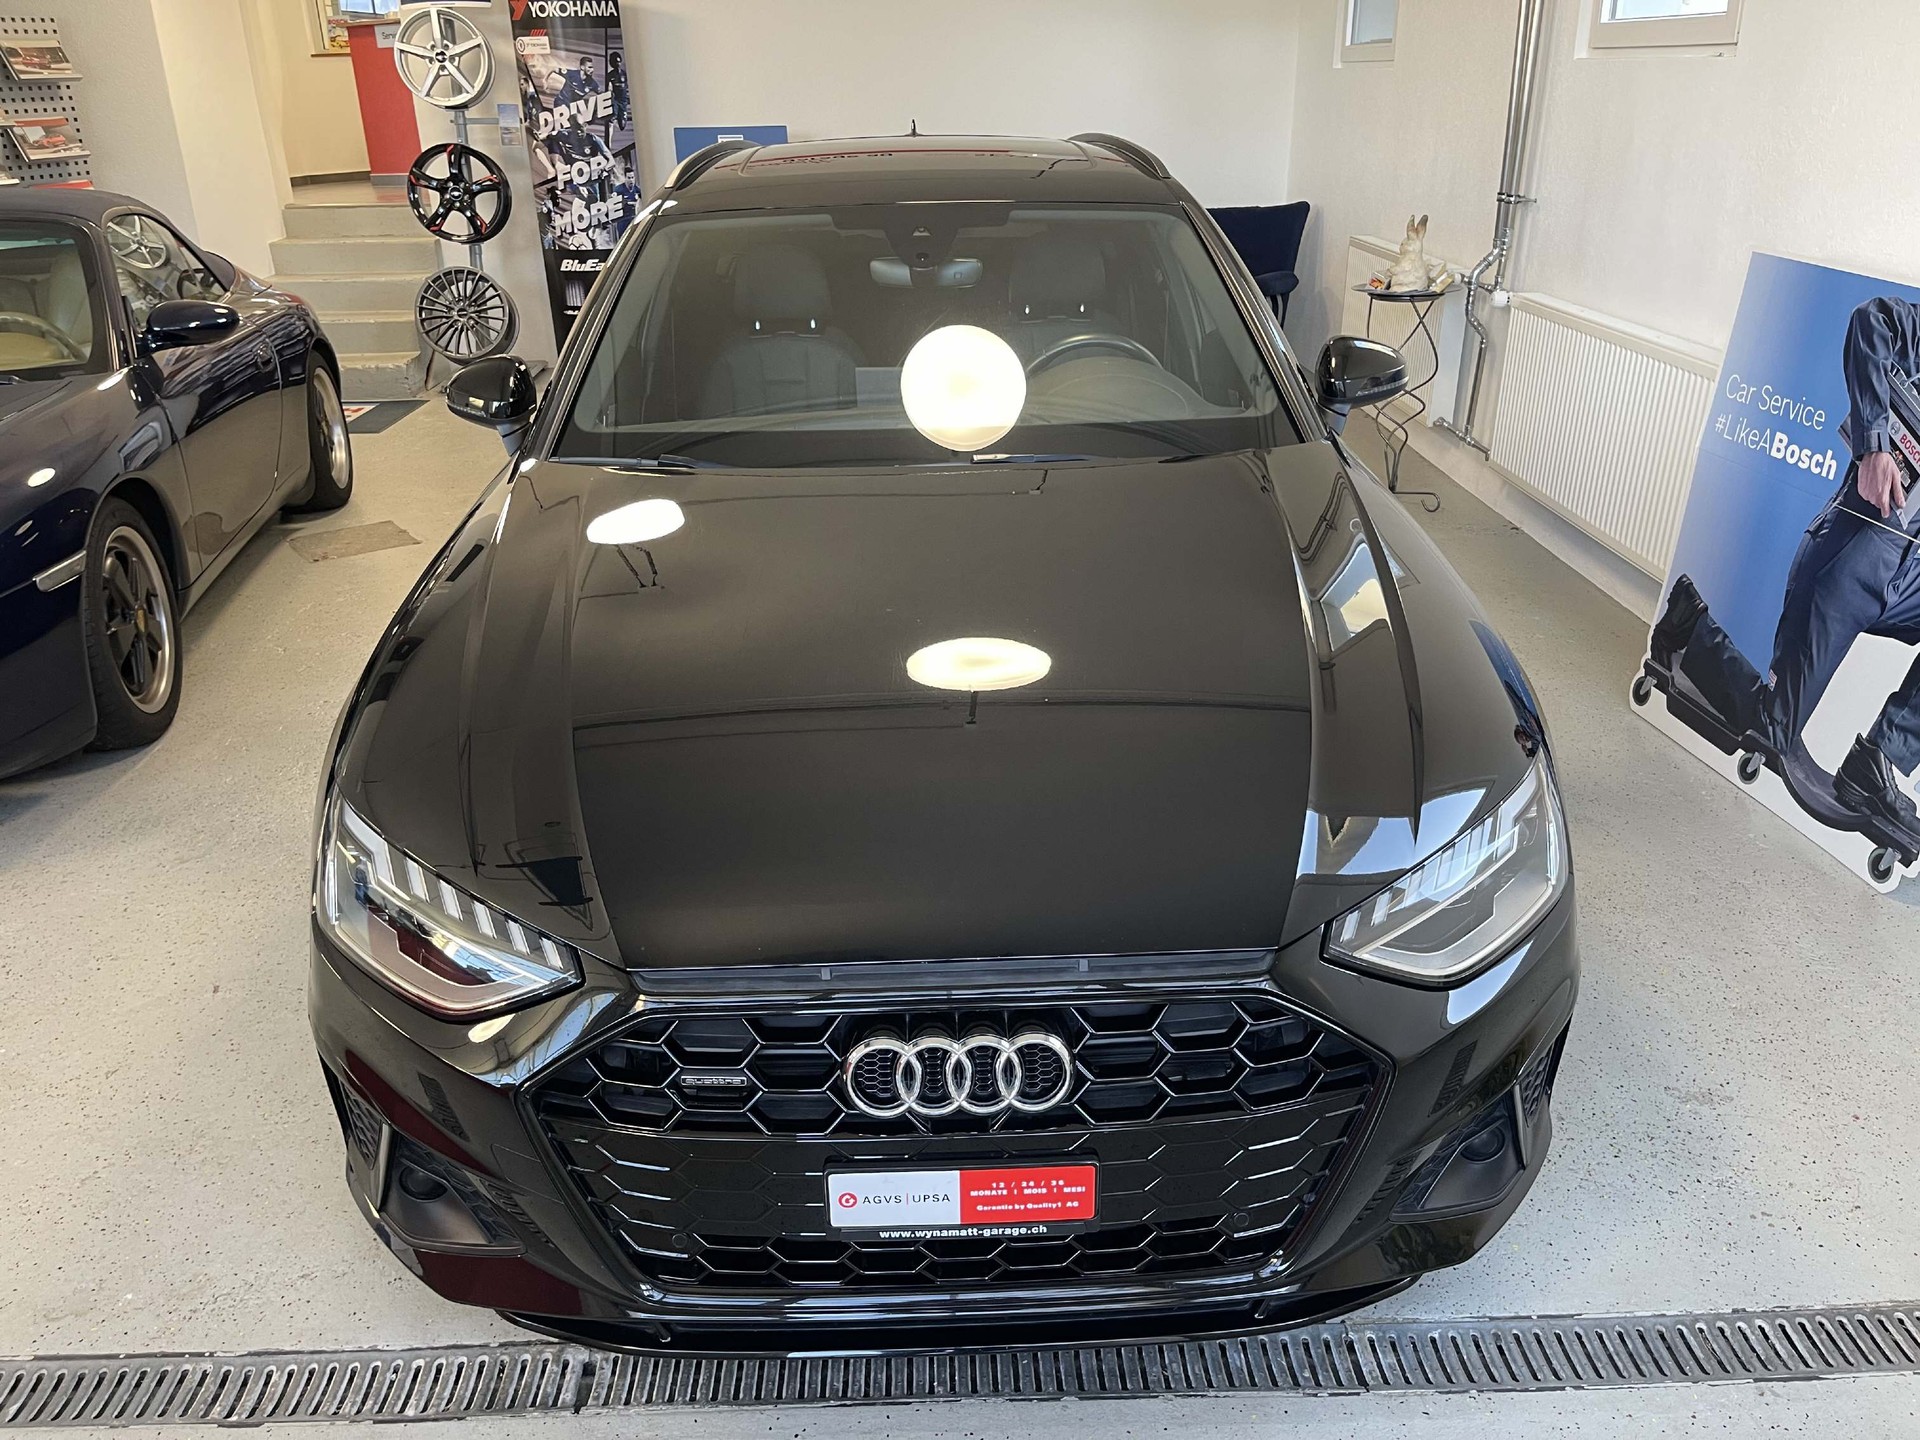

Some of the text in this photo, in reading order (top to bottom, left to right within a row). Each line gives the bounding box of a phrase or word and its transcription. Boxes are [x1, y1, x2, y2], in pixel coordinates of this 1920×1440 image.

[528, 0, 618, 18] YOKOHAMA
[553, 195, 624, 237] MORE
[1726, 374, 1826, 431] Car Service
[1714, 413, 1838, 481] #LikeABosch
[862, 1193, 951, 1205] AGVS UPSA
[879, 1225, 1048, 1239] www.wynamatt-garage.ch
